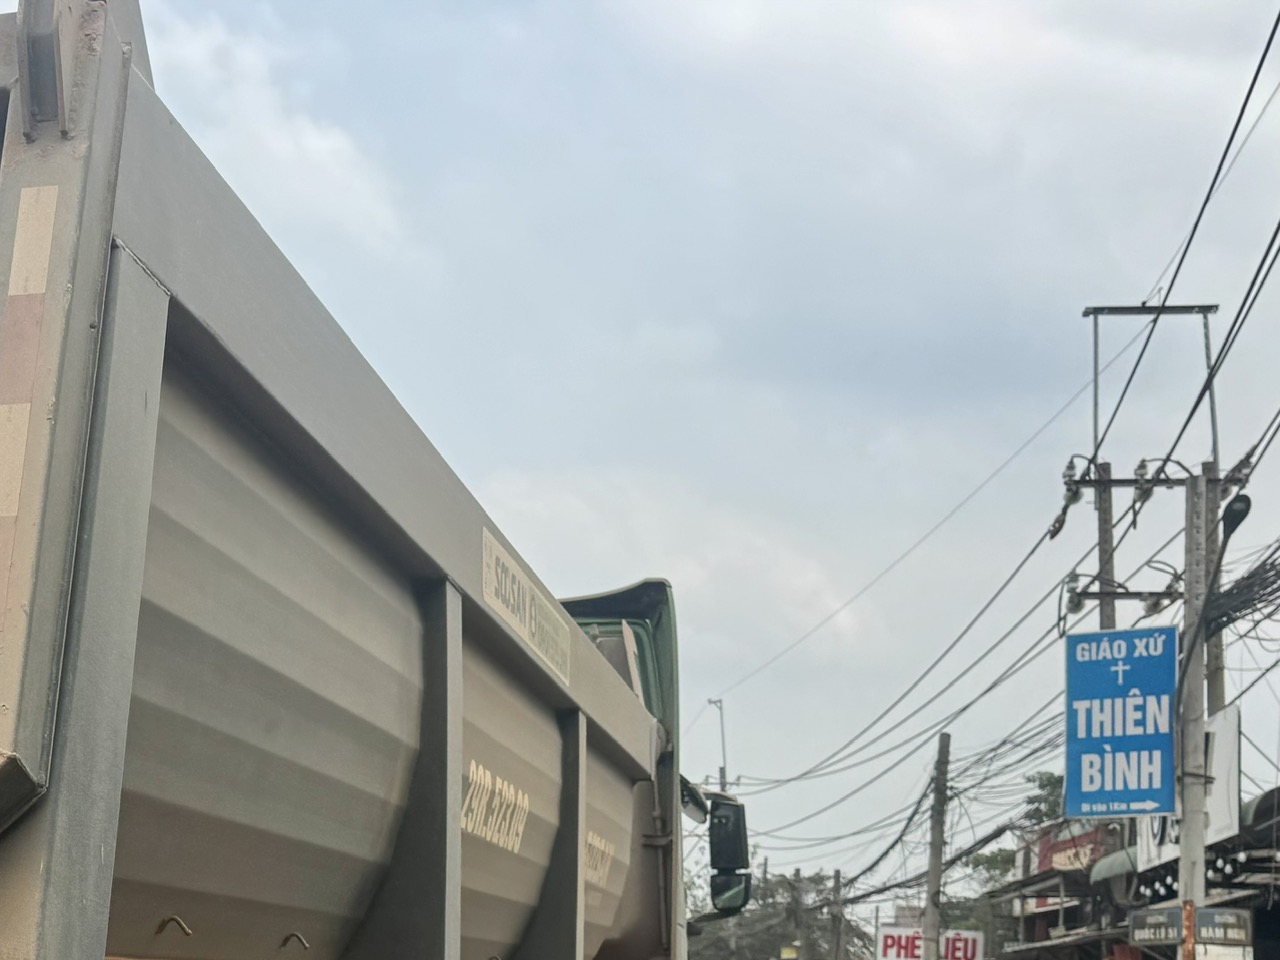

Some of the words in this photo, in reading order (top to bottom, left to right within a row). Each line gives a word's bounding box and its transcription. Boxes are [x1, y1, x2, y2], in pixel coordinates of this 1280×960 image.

[1076, 637, 1127, 662] GIÁO
[1133, 633, 1167, 658] XỨ
[1072, 688, 1170, 739] THIÊN
[1081, 744, 1162, 792] BÌNH
